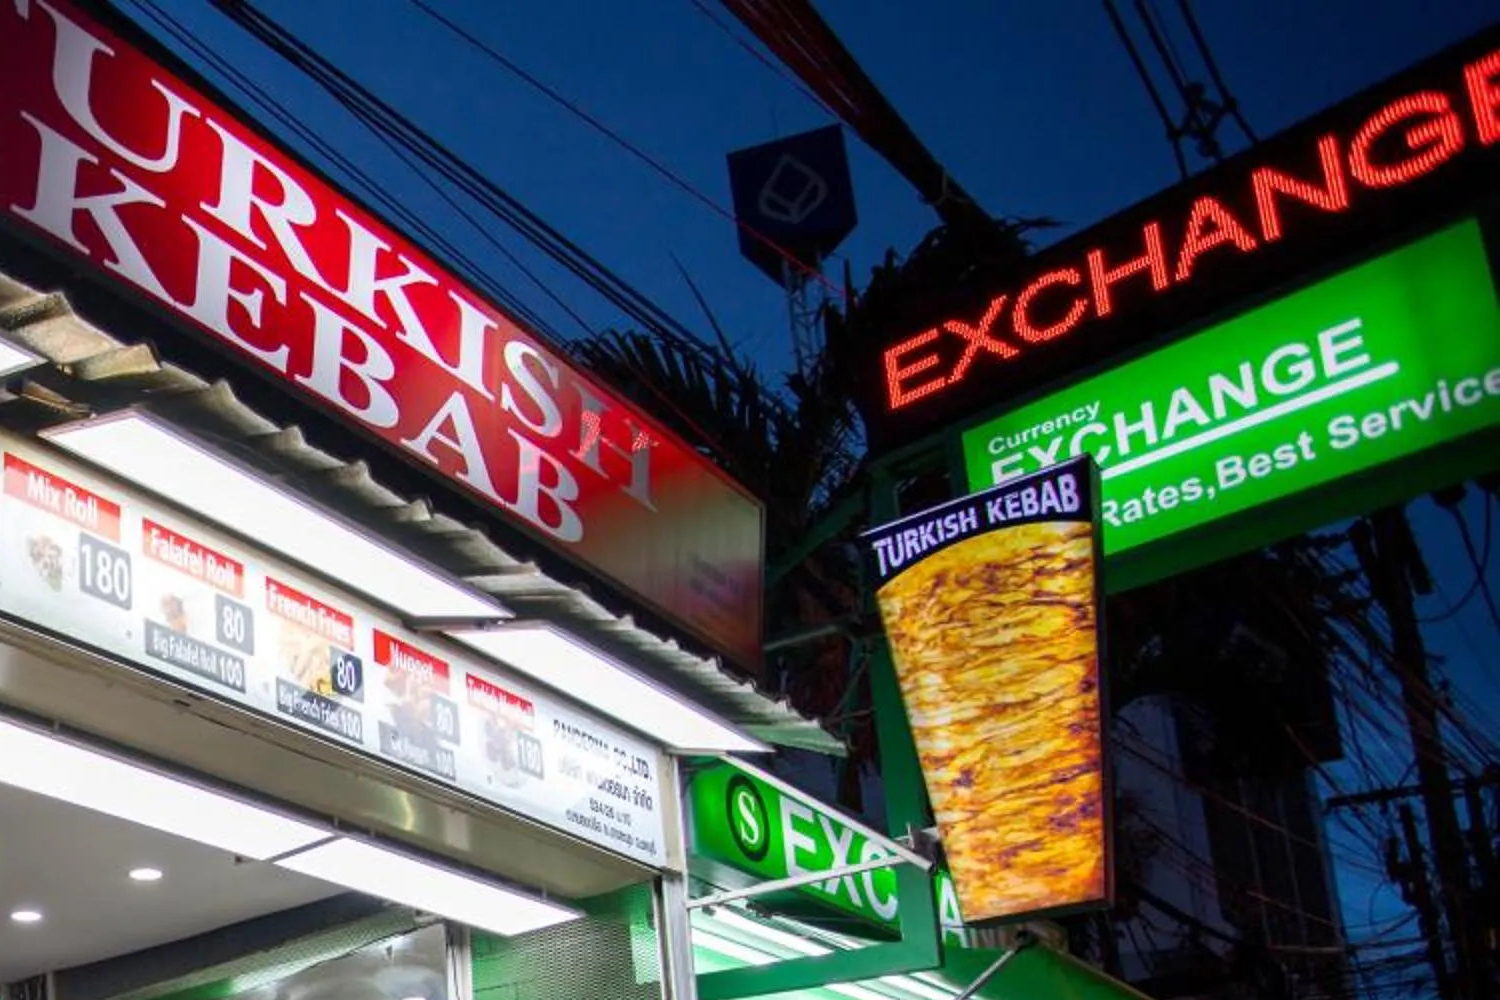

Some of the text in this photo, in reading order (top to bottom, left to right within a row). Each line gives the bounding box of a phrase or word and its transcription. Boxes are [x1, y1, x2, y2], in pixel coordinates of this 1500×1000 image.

[11, 111, 585, 544] KEBAB
[988, 401, 1100, 454] Currency
[991, 317, 1373, 486] EXCHANGE
[1326, 371, 1500, 450] Service
[26, 471, 98, 527] Mix Roll
[873, 473, 1082, 578] TURKISH KEBAB
[81, 544, 130, 602] 180
[150, 527, 235, 590] Falafel Roll
[221, 609, 245, 644] 80
[219, 655, 243, 689] 100
[336, 660, 355, 692] 80
